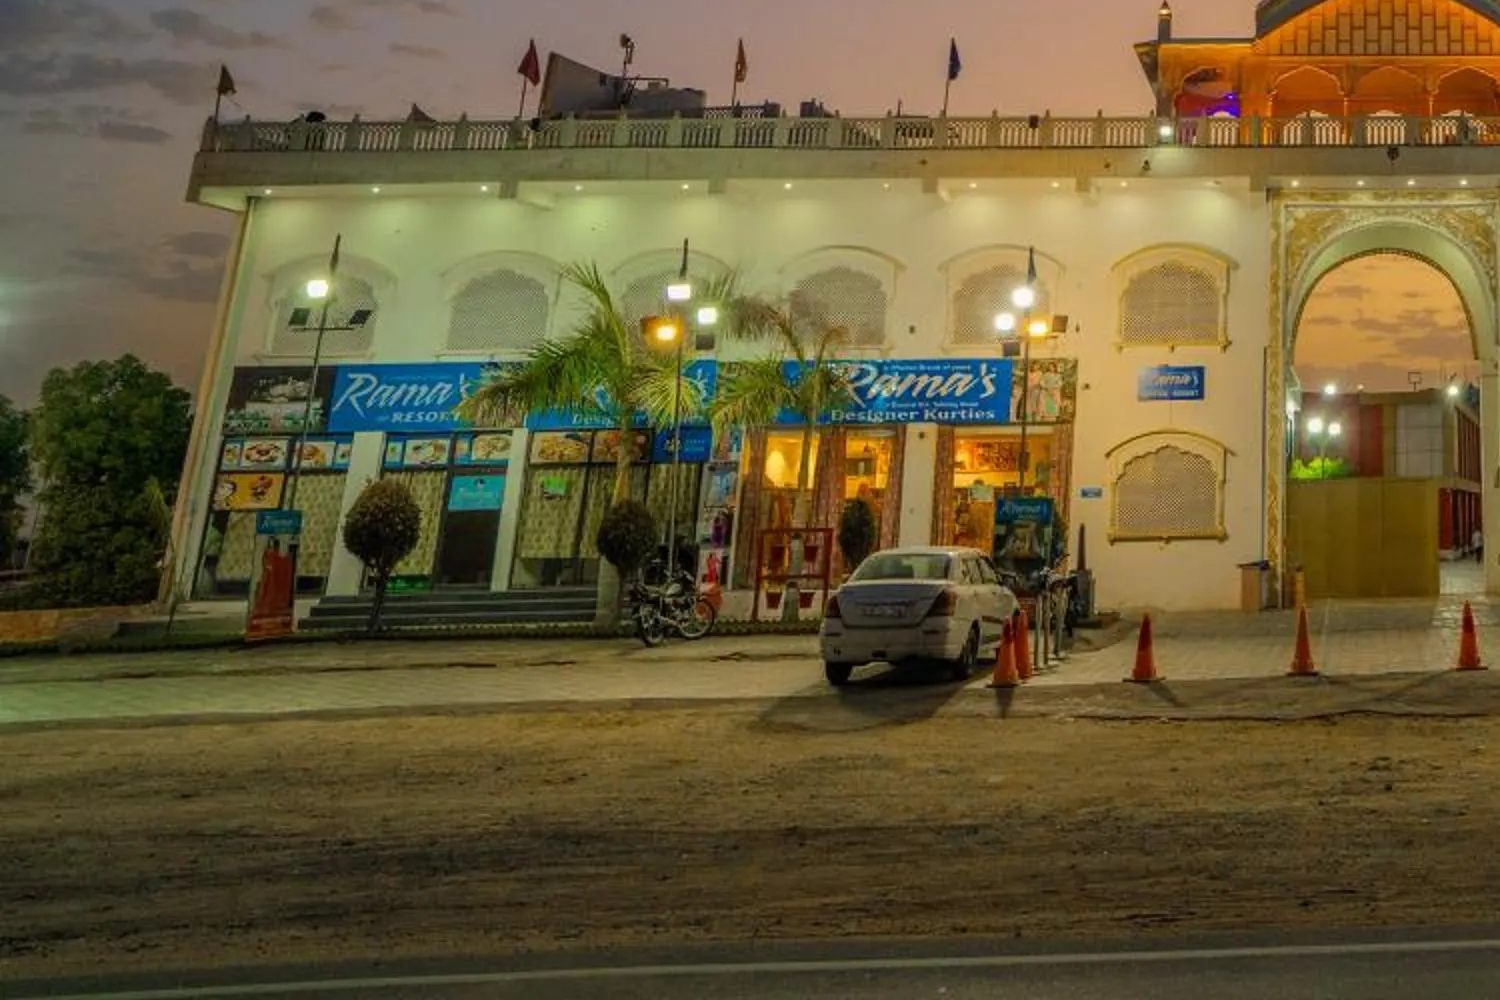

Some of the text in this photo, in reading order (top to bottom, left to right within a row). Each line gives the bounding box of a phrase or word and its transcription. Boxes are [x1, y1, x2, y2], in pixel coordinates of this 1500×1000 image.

[331, 372, 471, 418] Rama's
[838, 362, 997, 409] Rama's
[831, 406, 996, 423] Designer Kurties
